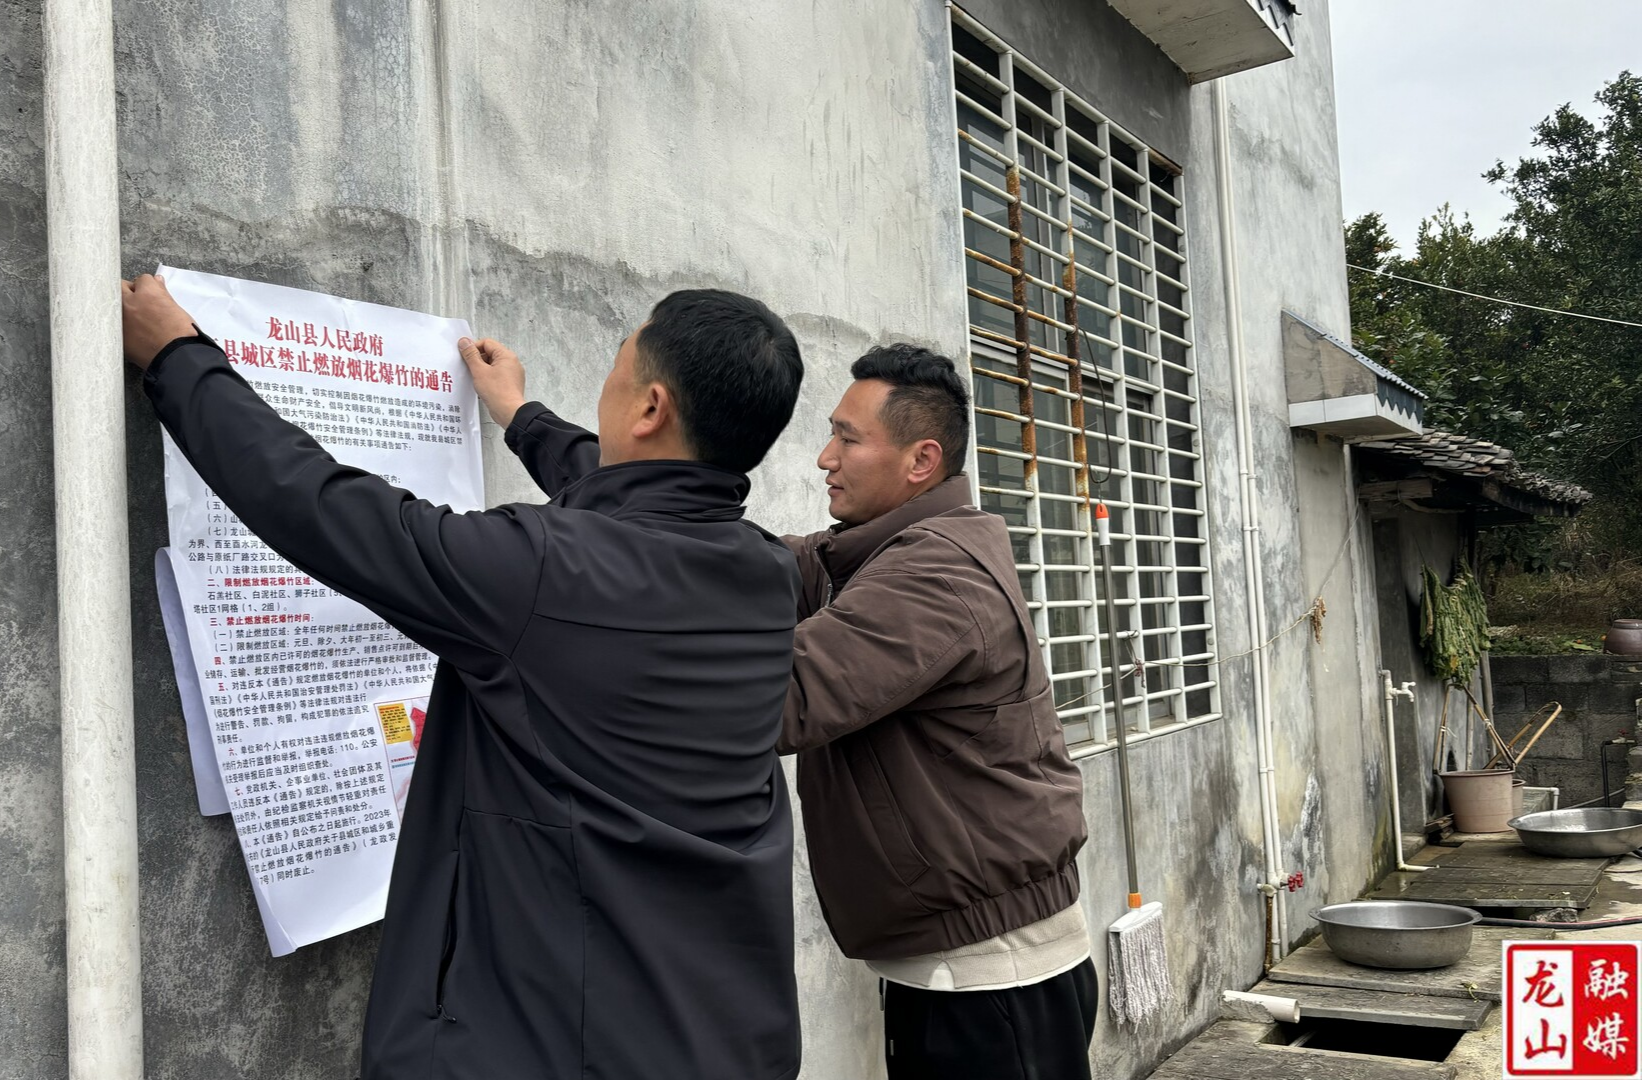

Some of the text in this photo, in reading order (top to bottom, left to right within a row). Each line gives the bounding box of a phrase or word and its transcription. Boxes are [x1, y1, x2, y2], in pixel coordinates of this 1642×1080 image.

[265, 316, 384, 357] 龙山县人民政府
[213, 338, 454, 393] 县城区禁止燃放烟花爆竹的通告
[311, 434, 412, 451] 烟花爆竹的有关事项通告如下：
[207, 577, 315, 587] 二、限制燃放烟花爆竹区域：
[210, 613, 314, 627] 三、禁止燃放烟花爆竹时间：
